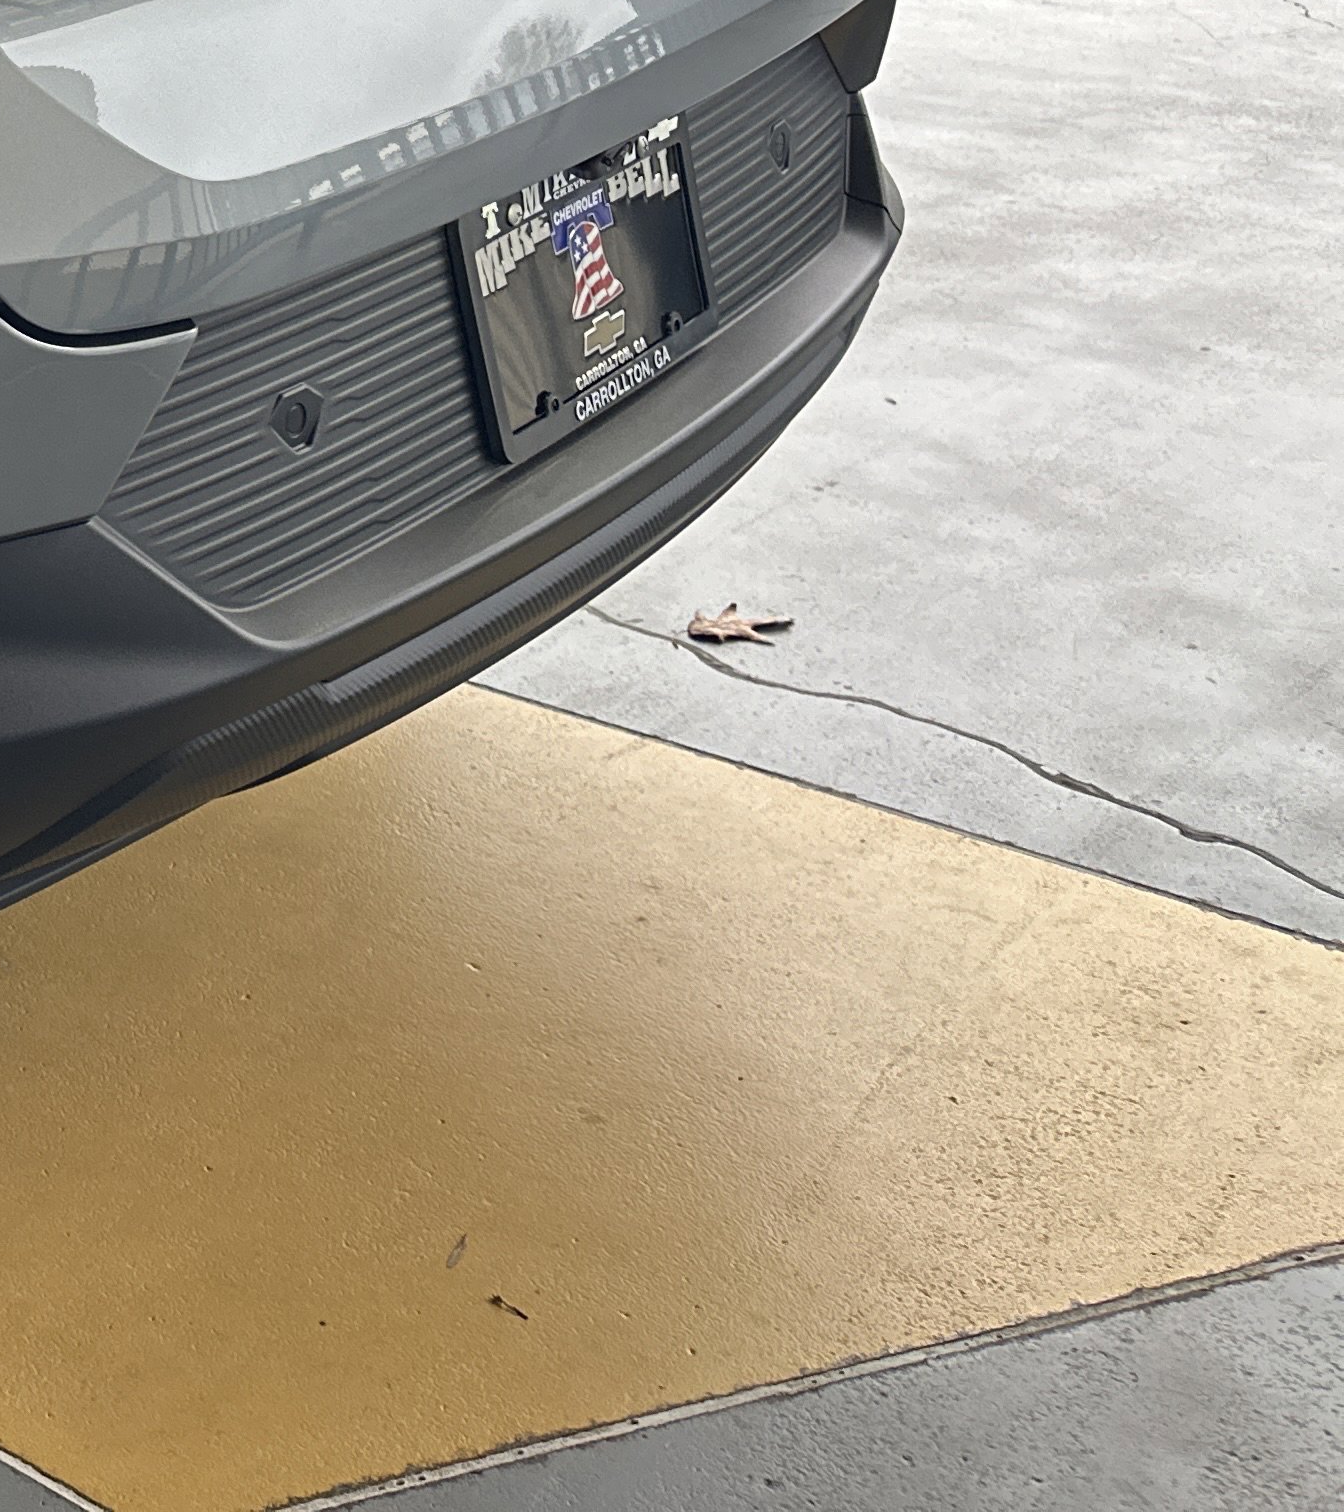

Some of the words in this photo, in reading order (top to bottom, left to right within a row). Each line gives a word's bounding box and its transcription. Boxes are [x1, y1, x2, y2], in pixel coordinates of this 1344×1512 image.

[474, 212, 552, 298] MIKE
[605, 147, 681, 203] BELL
[553, 188, 604, 226] CHEVROLET
[575, 345, 635, 391] CARROLLTON,
[575, 357, 655, 422] CARROLLTON,
[654, 345, 672, 369] GA
